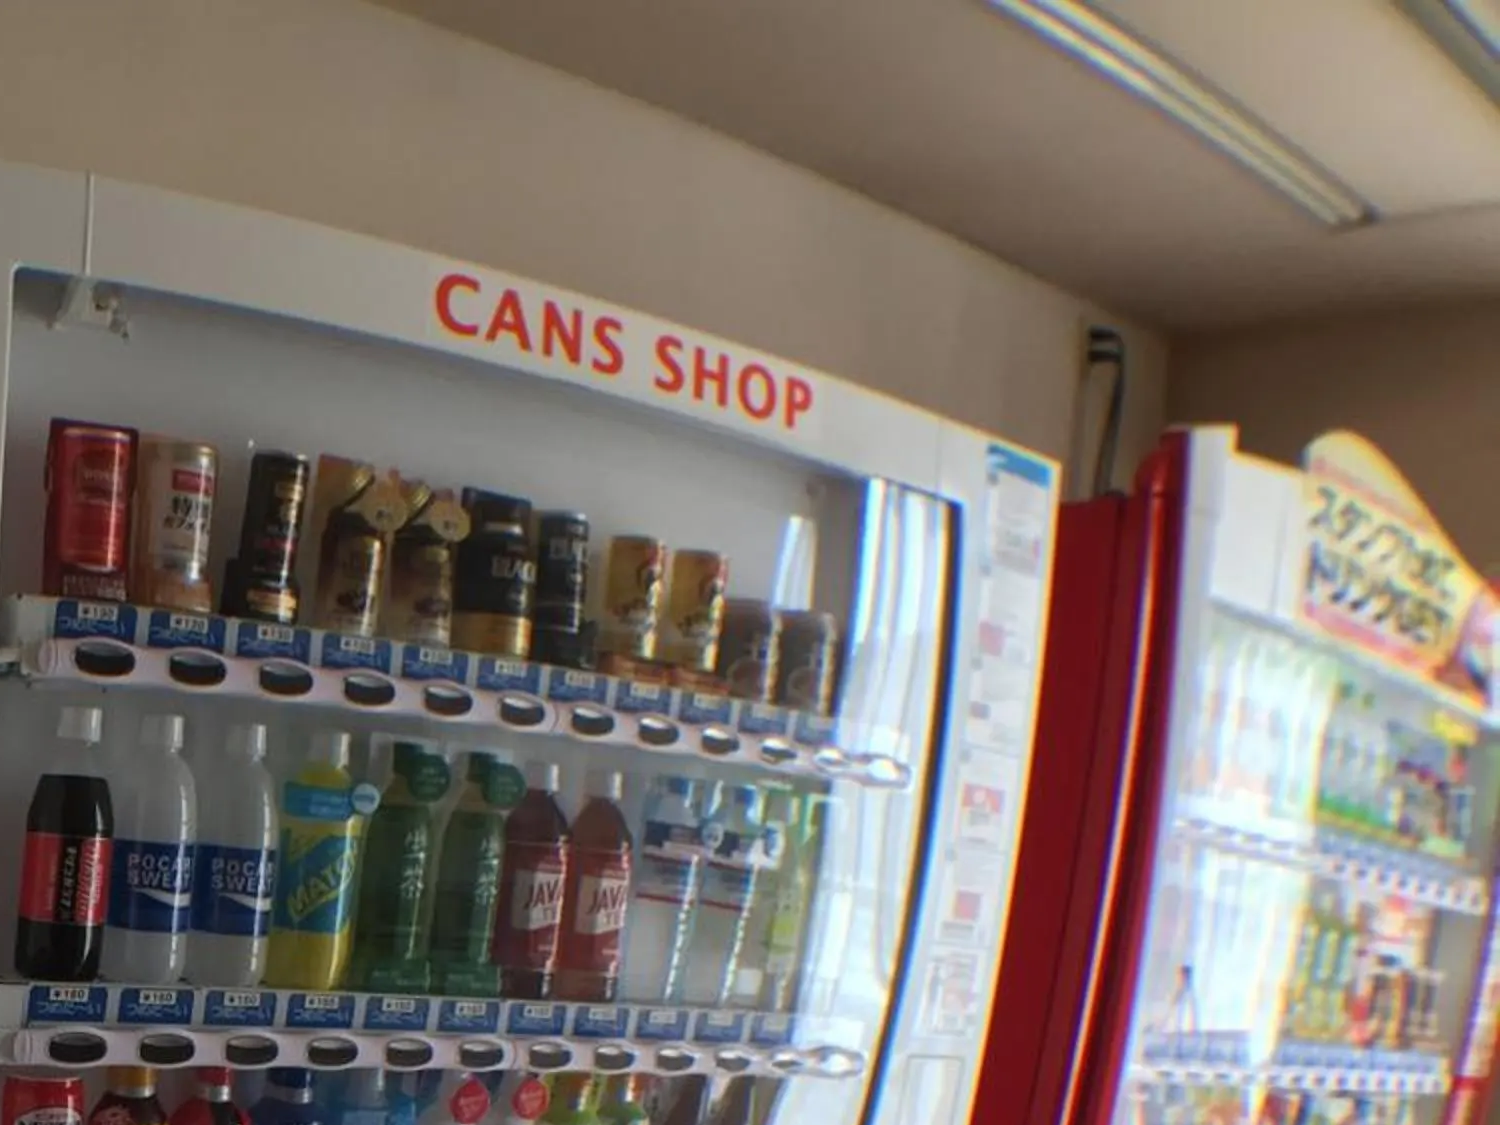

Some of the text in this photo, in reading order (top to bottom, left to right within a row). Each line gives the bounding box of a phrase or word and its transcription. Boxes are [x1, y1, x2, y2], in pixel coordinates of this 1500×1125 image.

[434, 273, 814, 429] CANS SHOP
[126, 870, 192, 889] SWEAT
[401, 827, 429, 901] 生茶
[474, 835, 502, 906] 生茶
